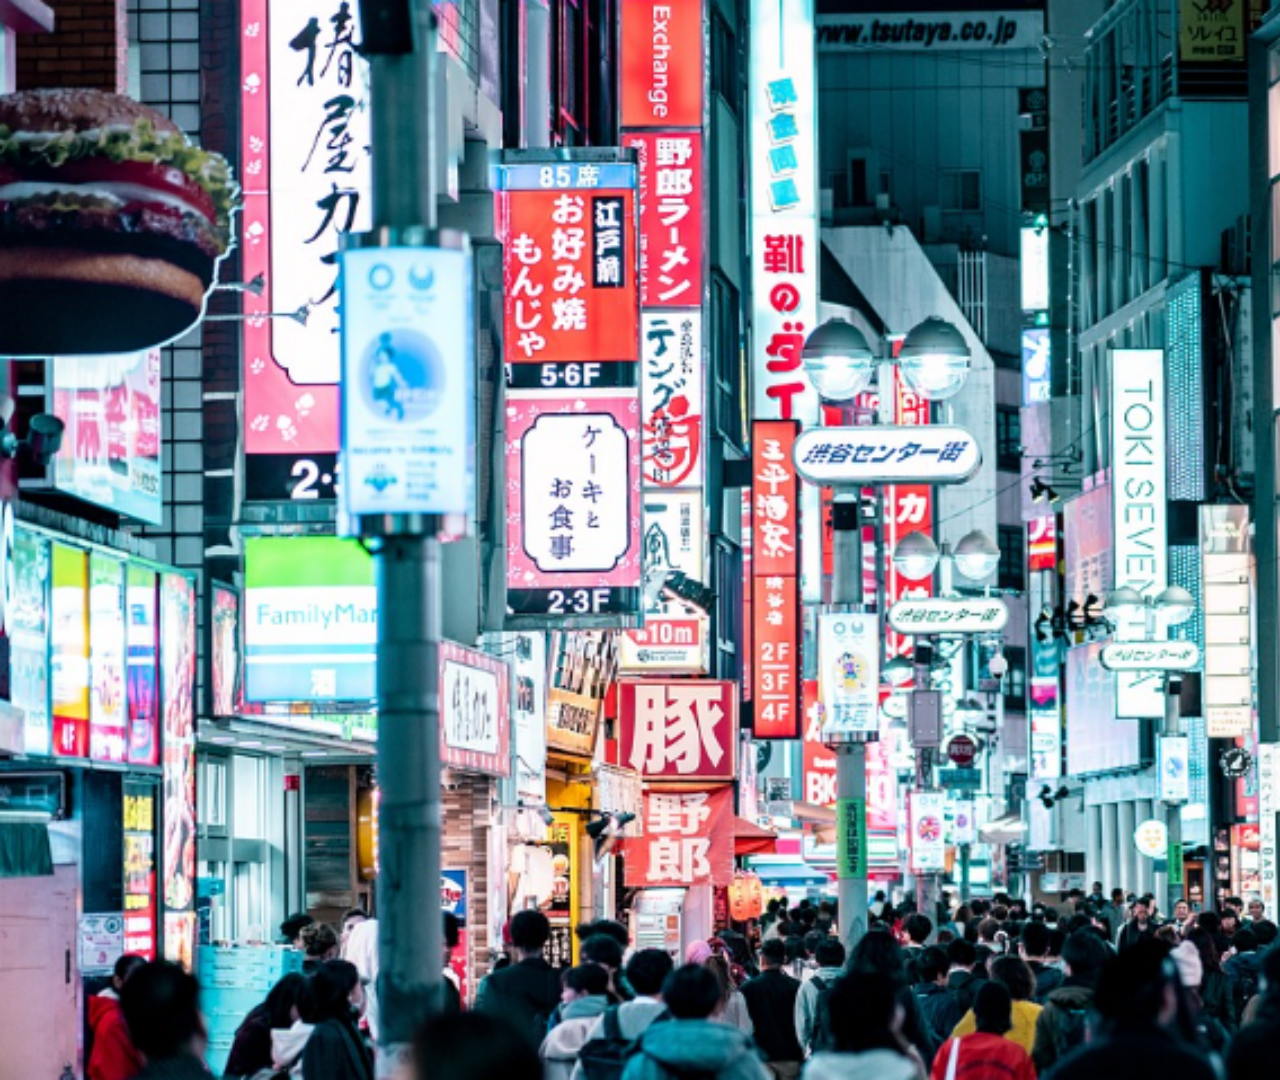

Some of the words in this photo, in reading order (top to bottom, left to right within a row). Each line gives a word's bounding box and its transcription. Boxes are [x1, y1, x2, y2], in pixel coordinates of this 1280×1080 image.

[650, 6, 671, 117] Exchange
[540, 166, 600, 188] 85席
[595, 201, 621, 284] 江戸前
[656, 137, 693, 302] 野郎ラーメン
[511, 233, 546, 357] もんじゃ
[552, 194, 587, 331] お好み焼
[802, 441, 969, 465] 渋谷センター街
[1124, 379, 1155, 466] TOKI
[549, 477, 576, 560] お食事
[582, 424, 603, 530] ケーキと
[256, 603, 378, 630] FamilyMar
[761, 642, 790, 662] 2F
[895, 608, 1001, 623] 渋谷センター街
[761, 672, 790, 692] 3F
[761, 702, 790, 721] 4F
[628, 684, 725, 775] 豚
[646, 792, 712, 882] 野郎
